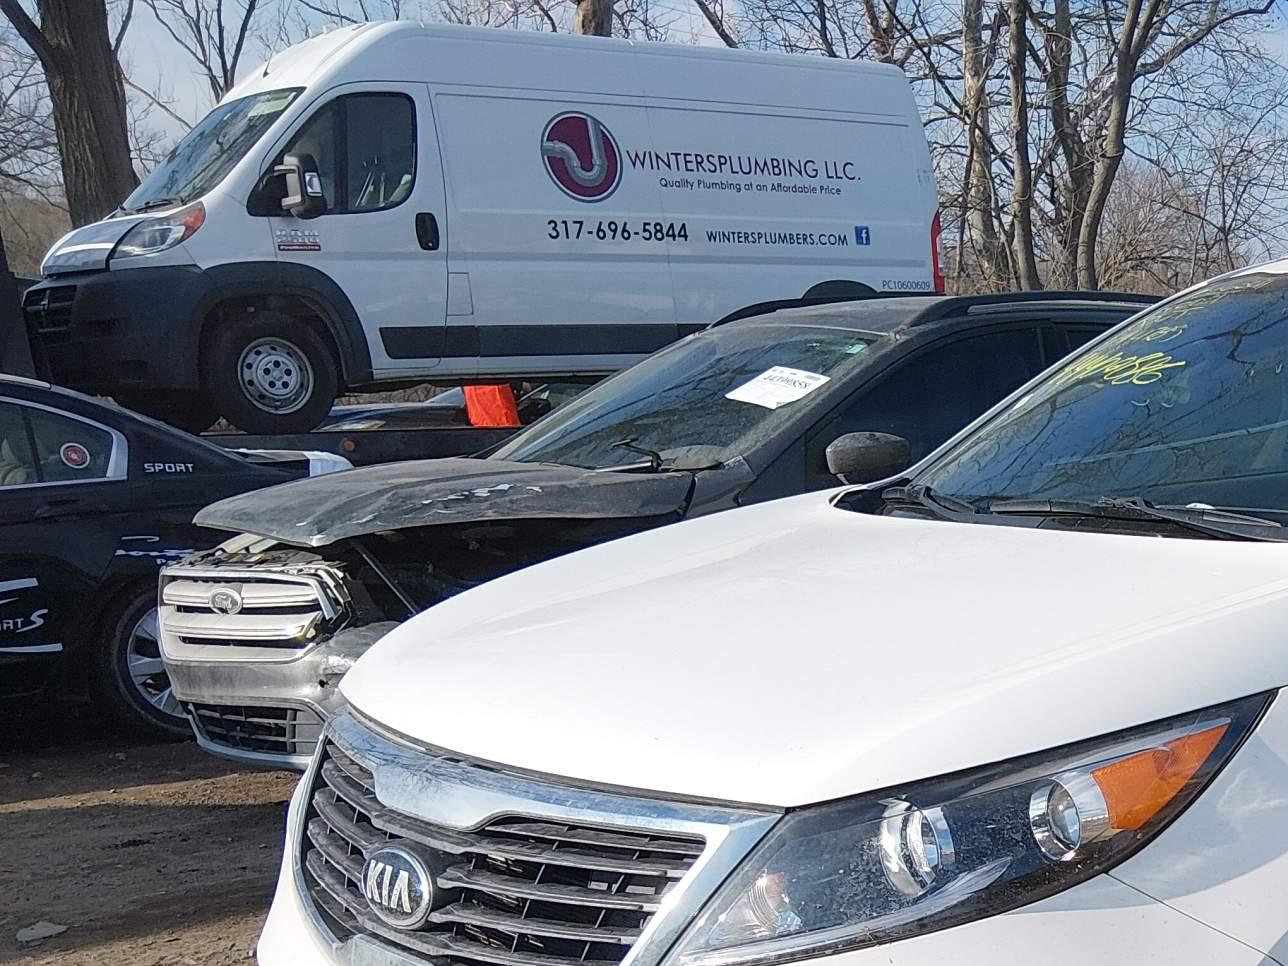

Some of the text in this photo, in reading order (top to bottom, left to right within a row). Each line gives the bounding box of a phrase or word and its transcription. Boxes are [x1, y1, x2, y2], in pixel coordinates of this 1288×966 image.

[626, 150, 861, 180] WINTERSPLUMBING LLC.
[660, 177, 841, 195] Quality Plumbing at an Affordable Price
[547, 219, 688, 241] 317-696-5844
[705, 230, 848, 246] WINTERSPLUMBERS.COM
[143, 462, 194, 473] SPORT
[366, 859, 411, 913] KIA
